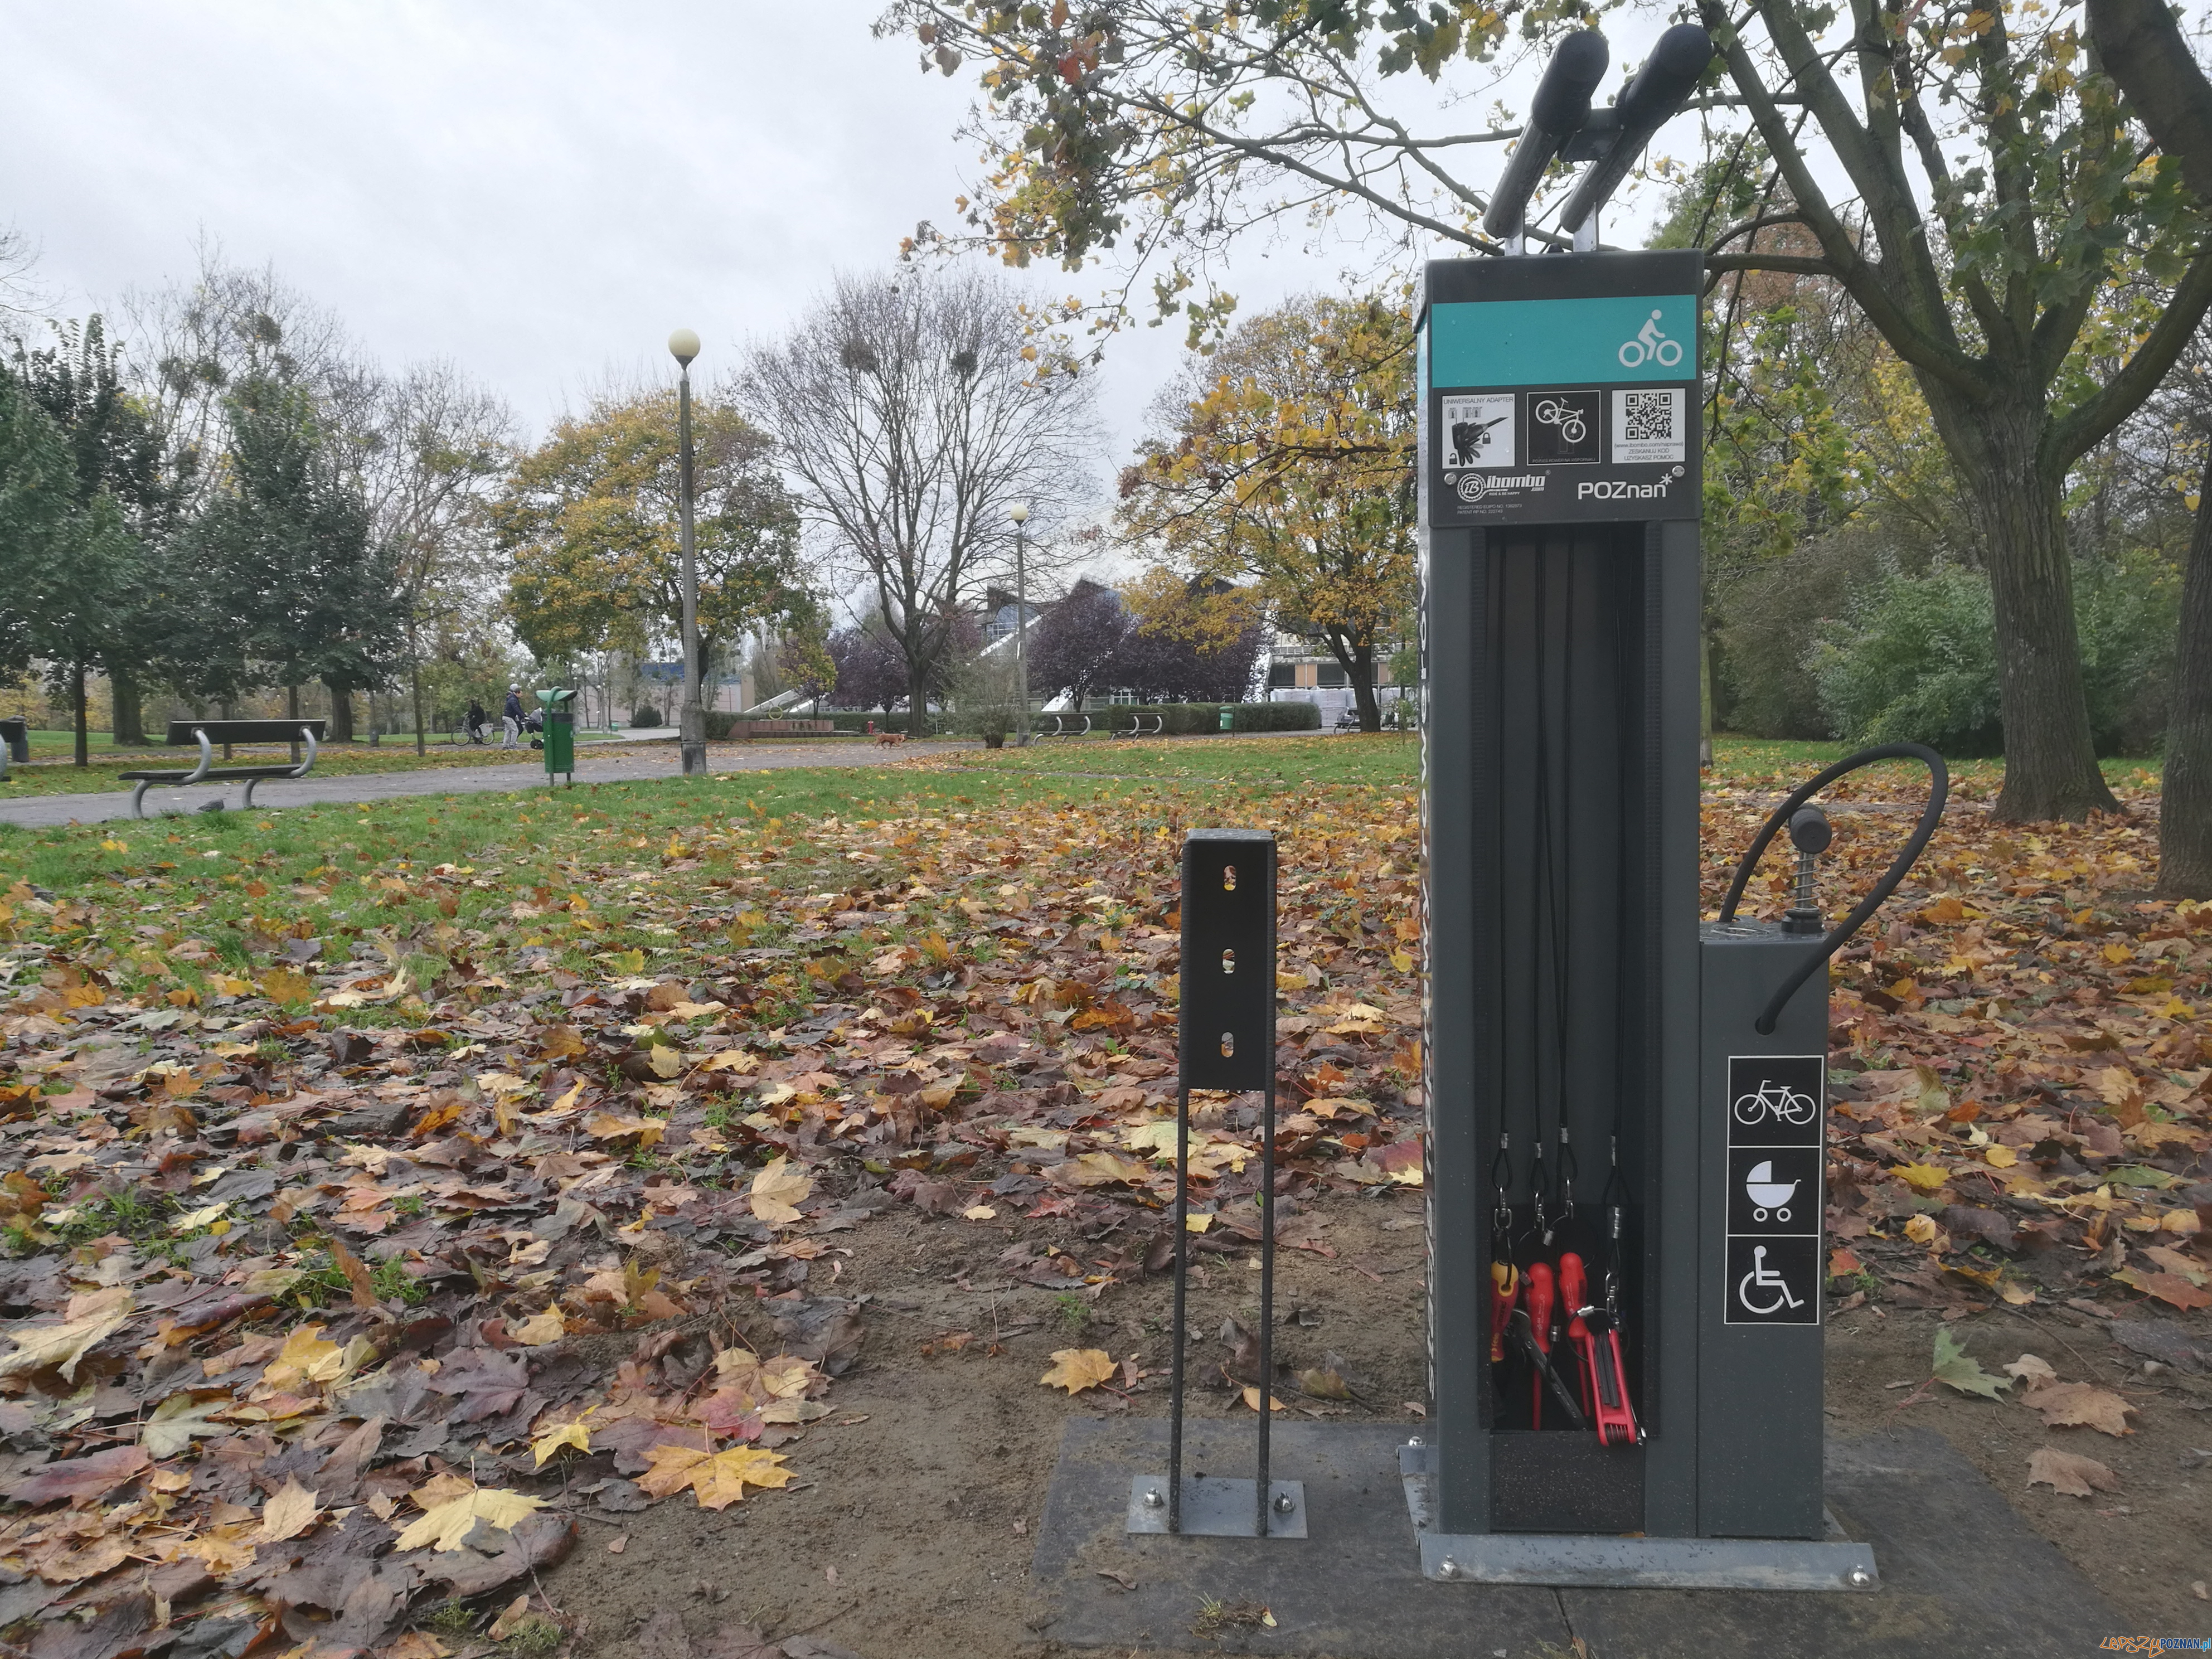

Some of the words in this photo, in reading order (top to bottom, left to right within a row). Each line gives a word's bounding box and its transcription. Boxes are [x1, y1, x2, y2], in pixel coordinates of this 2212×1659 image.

[1486, 474, 1546, 488] ibombo
[1422, 877, 1432, 1176] naprawy
[1425, 1195, 1434, 1400] stacja
